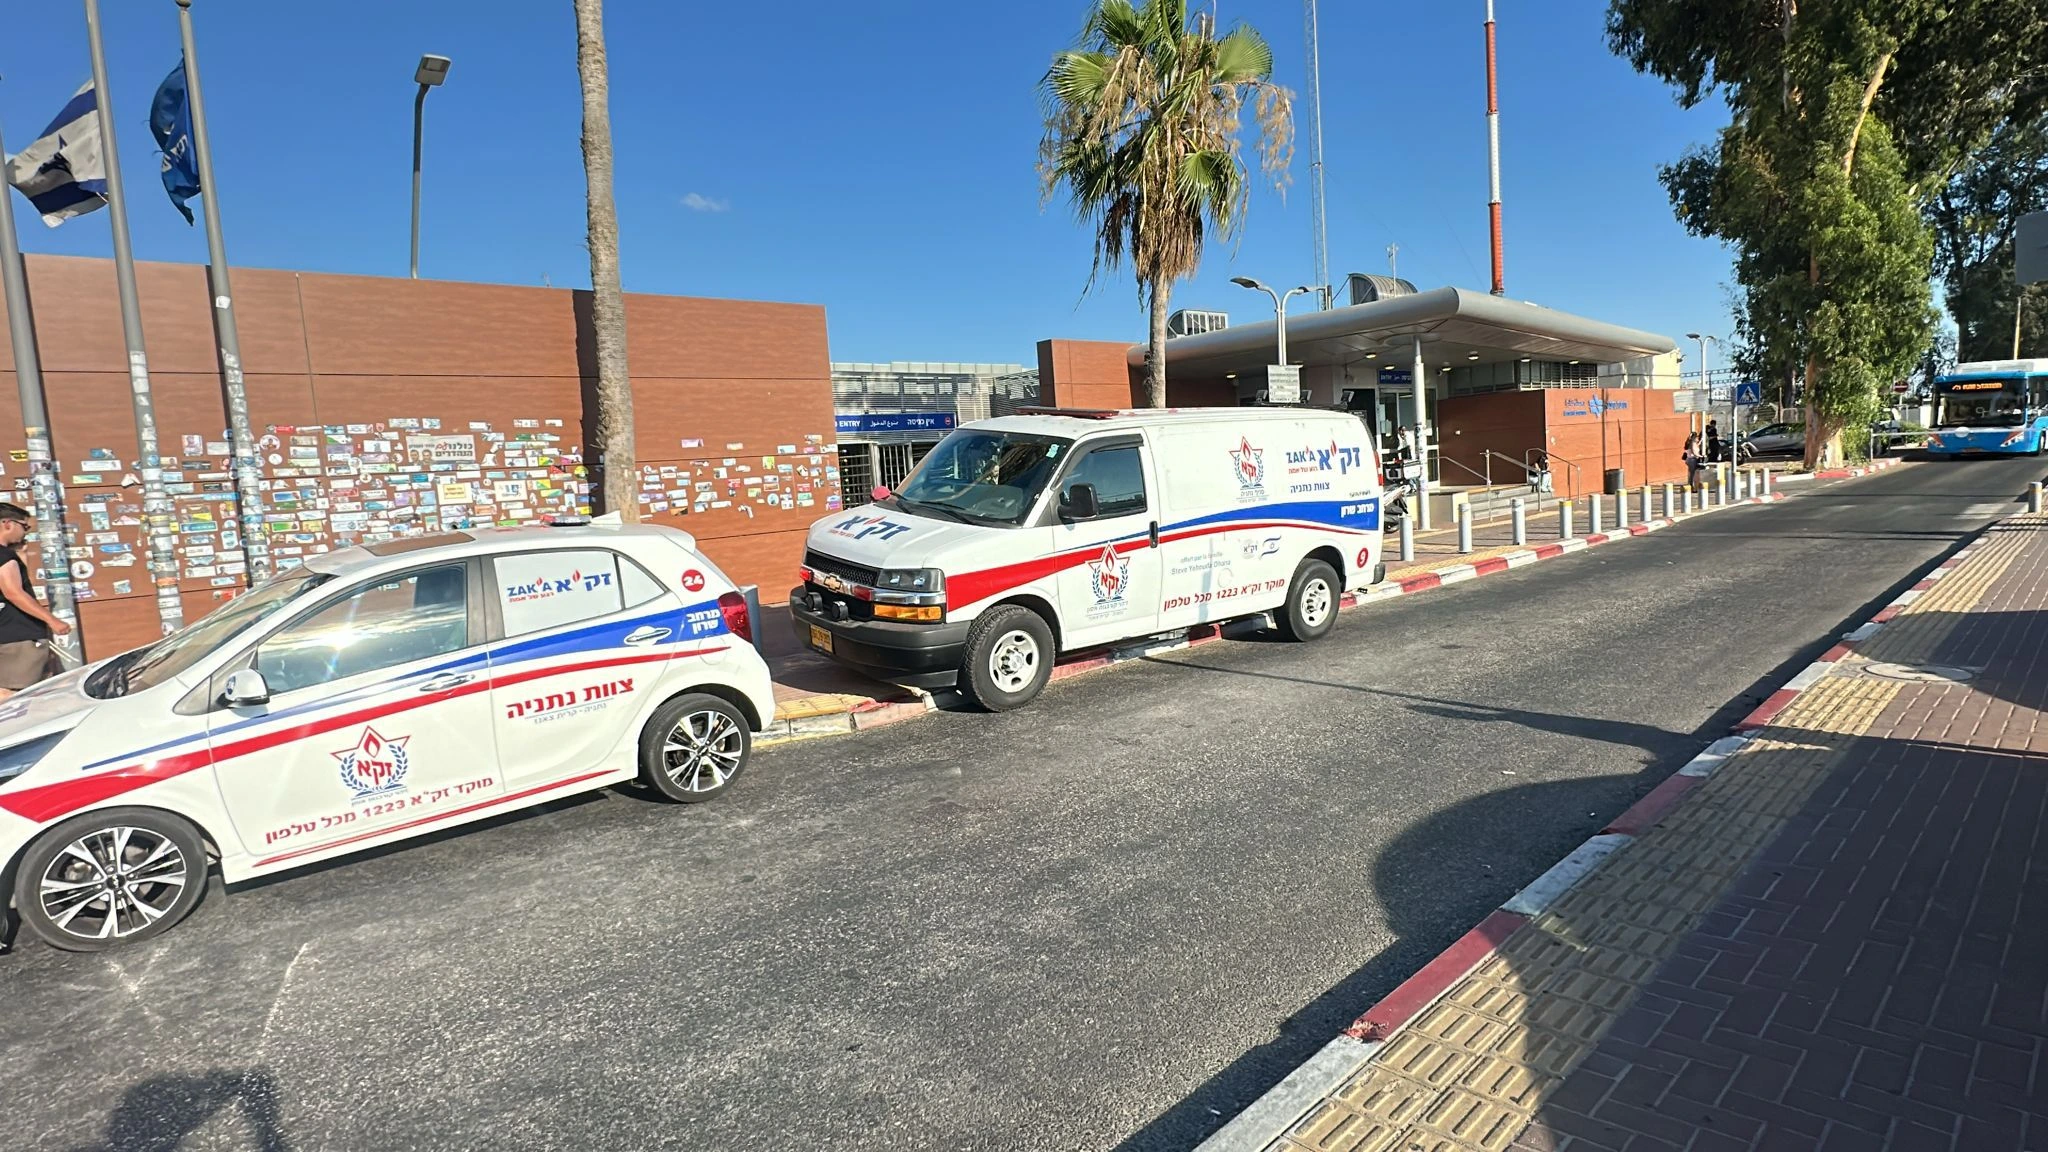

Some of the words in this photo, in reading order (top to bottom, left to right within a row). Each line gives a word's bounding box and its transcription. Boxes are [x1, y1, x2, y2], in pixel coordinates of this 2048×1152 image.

[1290, 484, 1312, 494] נתניה
[1313, 482, 1330, 491] צוות
[1359, 551, 1366, 565] 9
[1101, 572, 1119, 597] זקא
[1194, 592, 1212, 604] מכל
[1216, 587, 1238, 600] 1223
[1164, 596, 1191, 612] טלפון
[686, 609, 721, 623] מרחב
[692, 619, 719, 635] שרון
[583, 678, 634, 701] צוות
[506, 691, 576, 719] נתניה
[584, 702, 607, 713] נתניה
[357, 760, 393, 785] זקא
[453, 776, 494, 794] מוקד
[363, 800, 406, 818] 1223
[321, 811, 357, 829] מכל
[265, 821, 317, 844] טלפון
